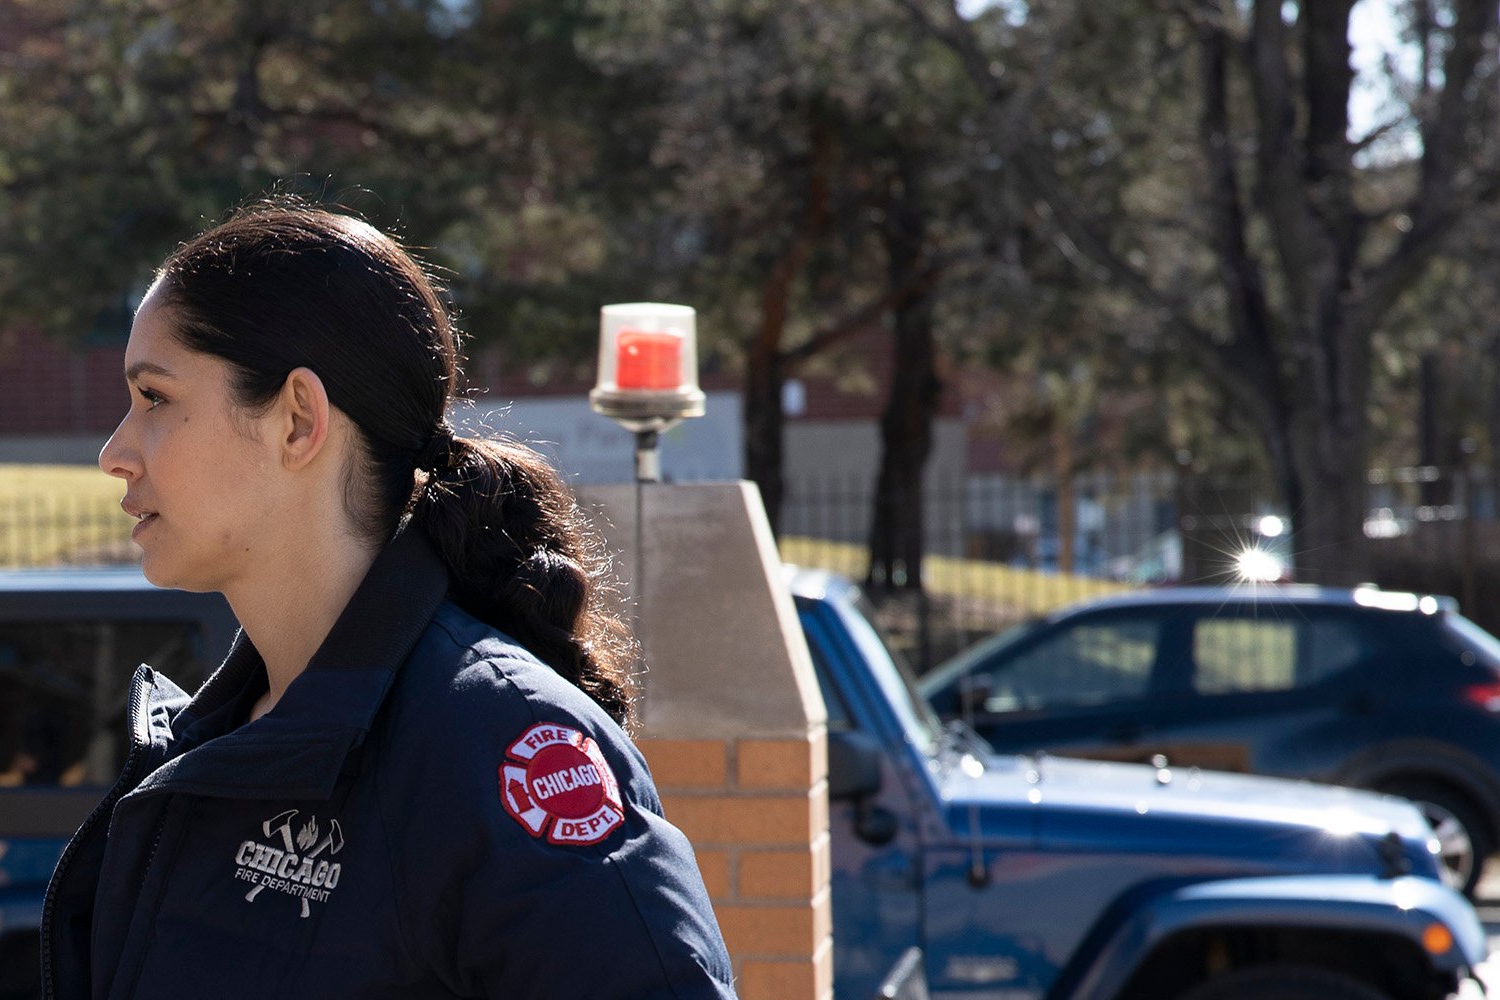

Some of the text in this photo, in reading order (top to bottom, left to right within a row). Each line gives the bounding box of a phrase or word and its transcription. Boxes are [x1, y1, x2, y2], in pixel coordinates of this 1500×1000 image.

[524, 729, 569, 750] FIRE
[532, 764, 601, 800] CHICAGO
[561, 811, 614, 837] DEPT.
[235, 840, 341, 889] CHICAGO
[234, 868, 331, 903] FIRE DEPARTMENT
